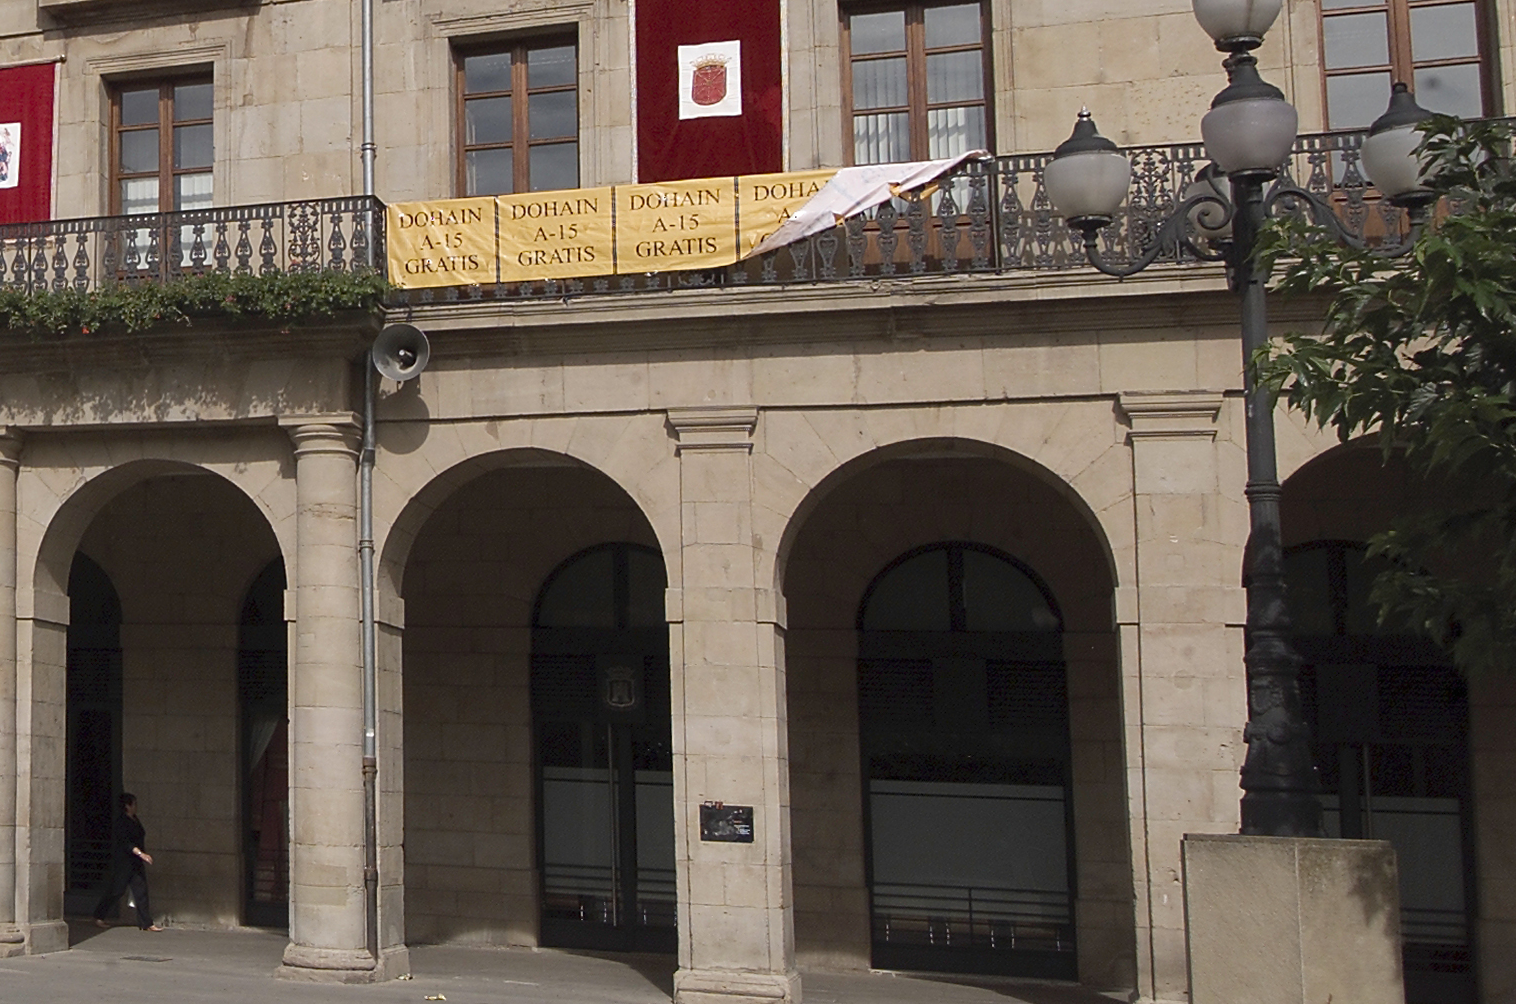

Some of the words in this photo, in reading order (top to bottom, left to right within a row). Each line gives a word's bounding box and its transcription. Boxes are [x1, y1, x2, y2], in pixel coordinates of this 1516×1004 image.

[630, 189, 721, 211] DOHAIN
[754, 181, 831, 202] DOHA
[399, 208, 482, 228] DOHAIN
[512, 198, 598, 220] DOHAIN
[533, 224, 578, 242] A-15
[652, 214, 699, 233] A-15
[420, 233, 463, 250] A-15
[635, 237, 717, 258] GRATIS
[405, 255, 479, 275] GRATIS
[518, 246, 595, 267] GRATIS
